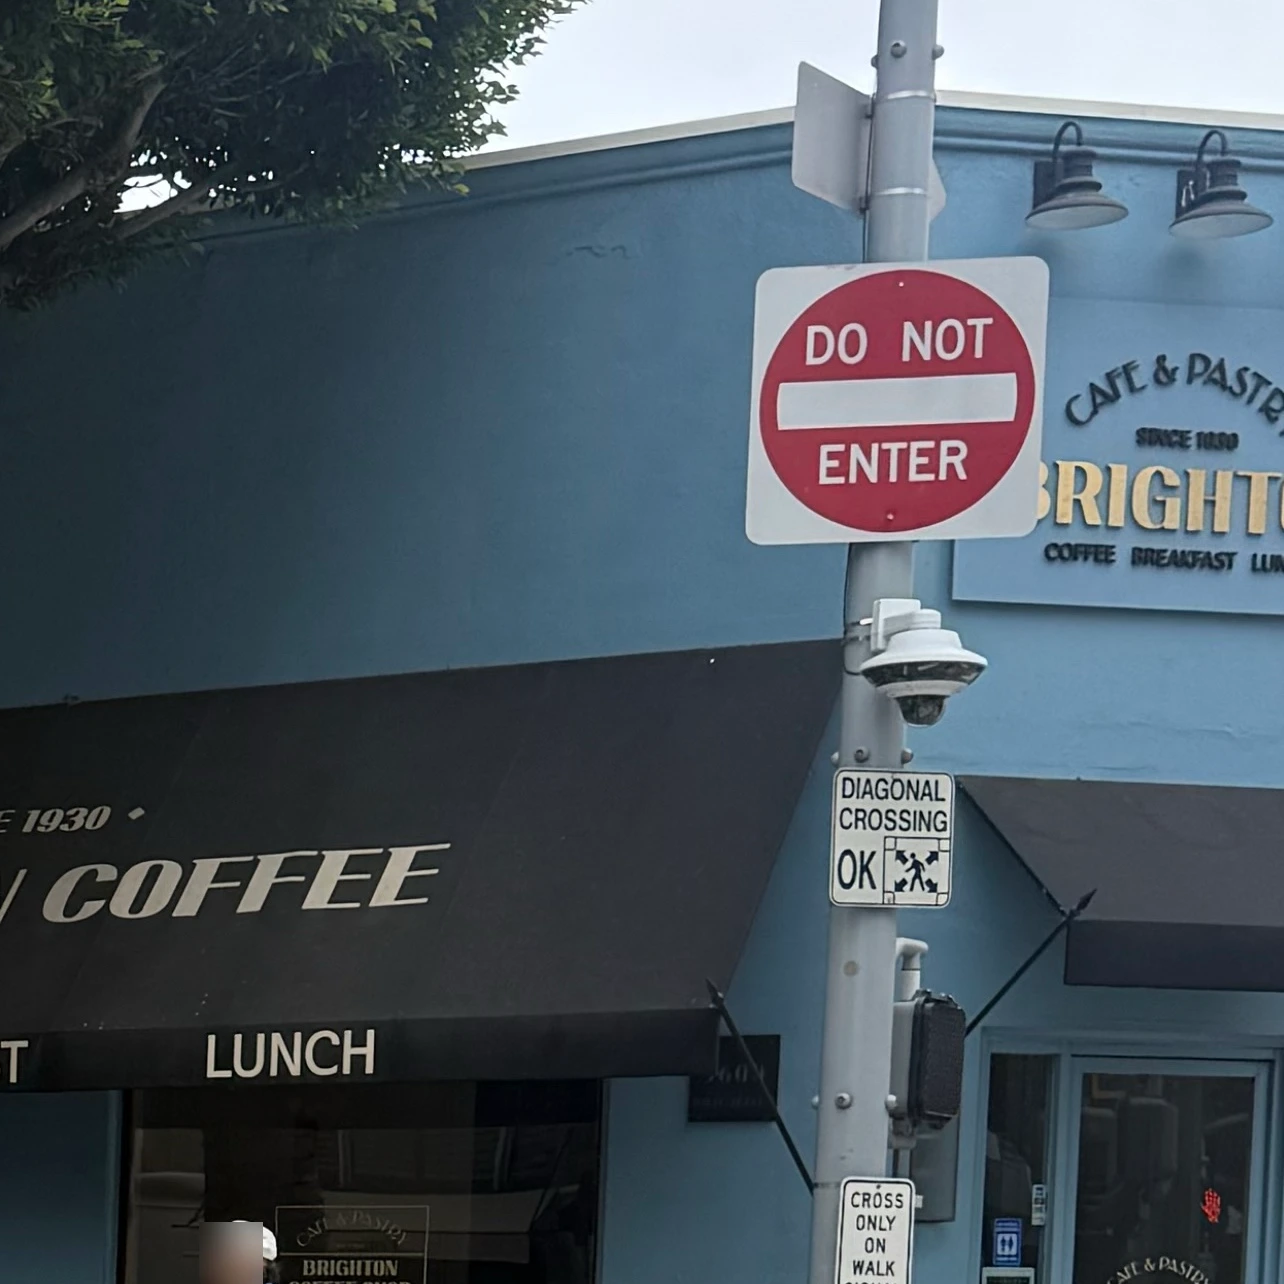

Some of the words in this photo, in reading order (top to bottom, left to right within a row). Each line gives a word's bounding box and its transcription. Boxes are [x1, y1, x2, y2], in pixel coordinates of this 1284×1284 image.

[805, 322, 868, 366] DO
[901, 317, 994, 362] NOT
[1065, 359, 1149, 426] CAFE
[1153, 353, 1180, 387] &
[1186, 352, 1284, 438] PASTR
[1135, 427, 1193, 450] SINCE
[818, 439, 968, 485] ENTER
[1037, 460, 1284, 536] RIGHT
[1044, 542, 1117, 564] COFFEE
[1130, 546, 1239, 571] BREAKFAST
[841, 776, 947, 802] DIAGONAL
[21, 804, 112, 834] 1930
[839, 807, 948, 832] CROSSING
[41, 842, 452, 924] COFFEE
[837, 848, 877, 891] OK
[205, 1028, 377, 1079] LUNCH
[850, 1191, 904, 1209] CROSS
[856, 1214, 896, 1231] ONLY
[864, 1237, 886, 1254] ON
[303, 1259, 398, 1276] BRIGHTON
[852, 1260, 895, 1277] WALK
[1144, 1258, 1156, 1272] &
